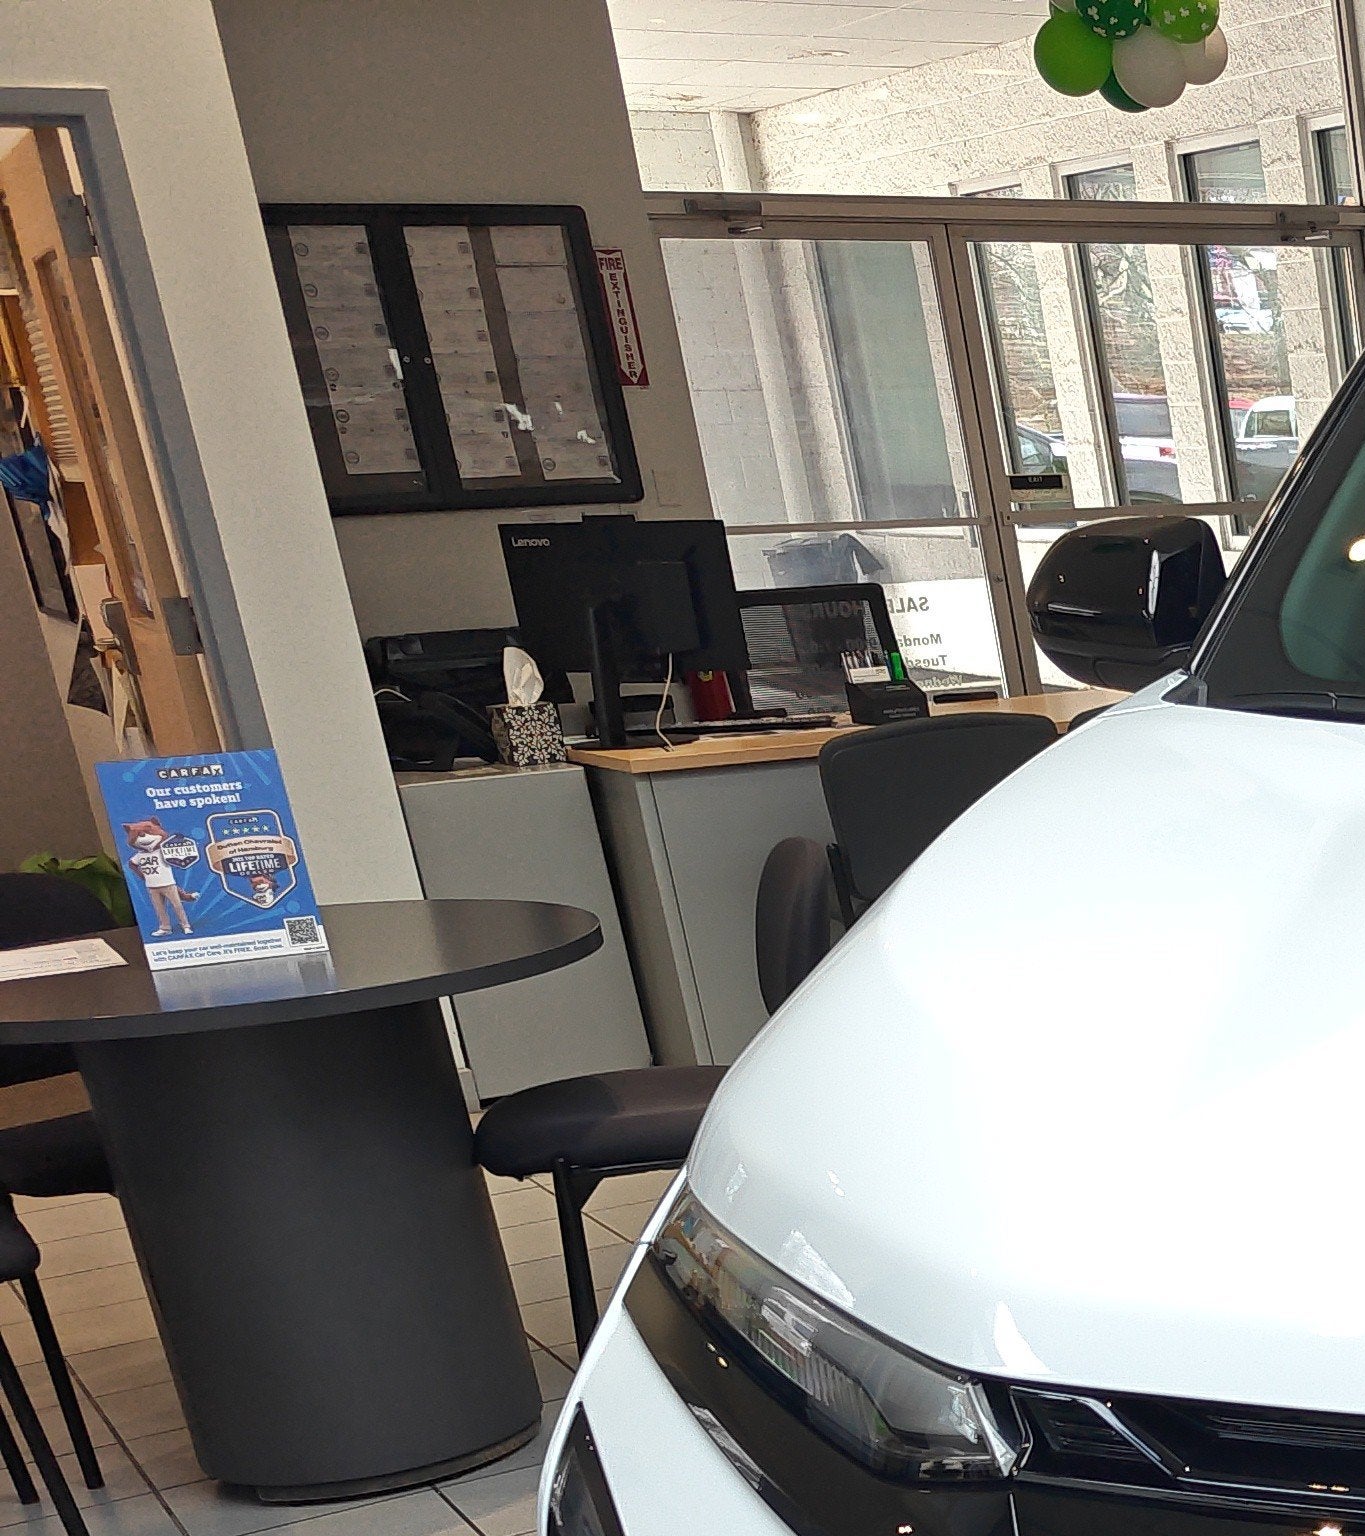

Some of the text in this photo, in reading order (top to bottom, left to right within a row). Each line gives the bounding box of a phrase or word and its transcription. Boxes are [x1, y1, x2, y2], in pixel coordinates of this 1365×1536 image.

[598, 257, 623, 271] FIRE
[609, 272, 638, 378] EXTINGUISHER
[511, 536, 550, 547] Lenovo
[158, 764, 224, 779] CARFAX
[145, 781, 243, 798] Our customers
[153, 793, 241, 810] have spoken!
[140, 856, 159, 866] CAR
[228, 858, 282, 873] LIFETIME
